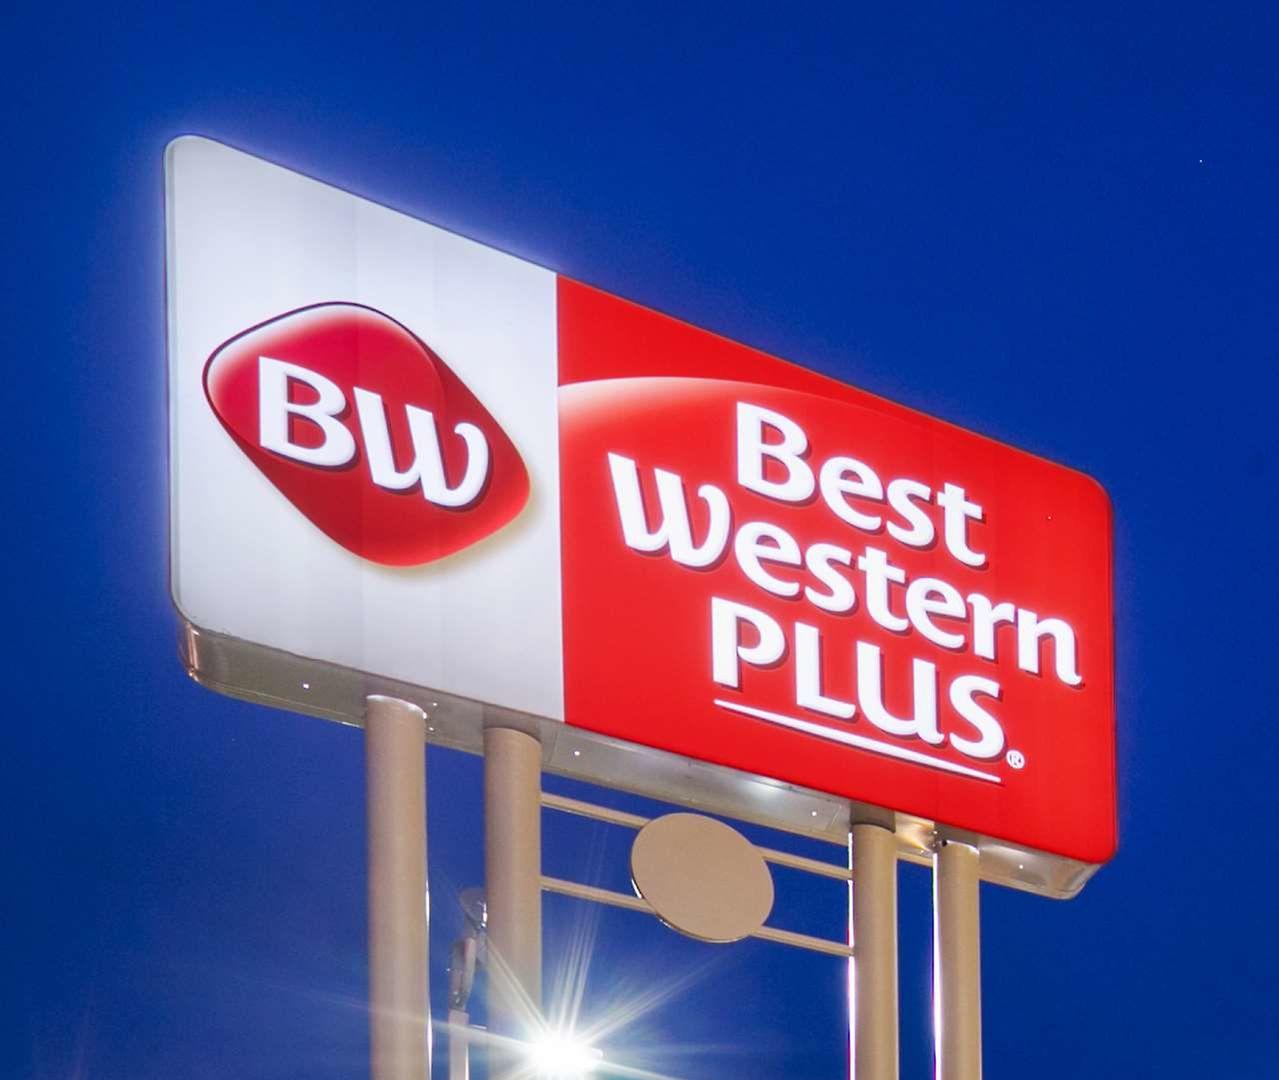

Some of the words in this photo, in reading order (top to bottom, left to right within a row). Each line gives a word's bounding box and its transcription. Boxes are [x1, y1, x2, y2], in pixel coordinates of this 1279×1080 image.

[259, 357, 488, 507] BW
[736, 402, 986, 567] Best
[607, 453, 1082, 686] Western
